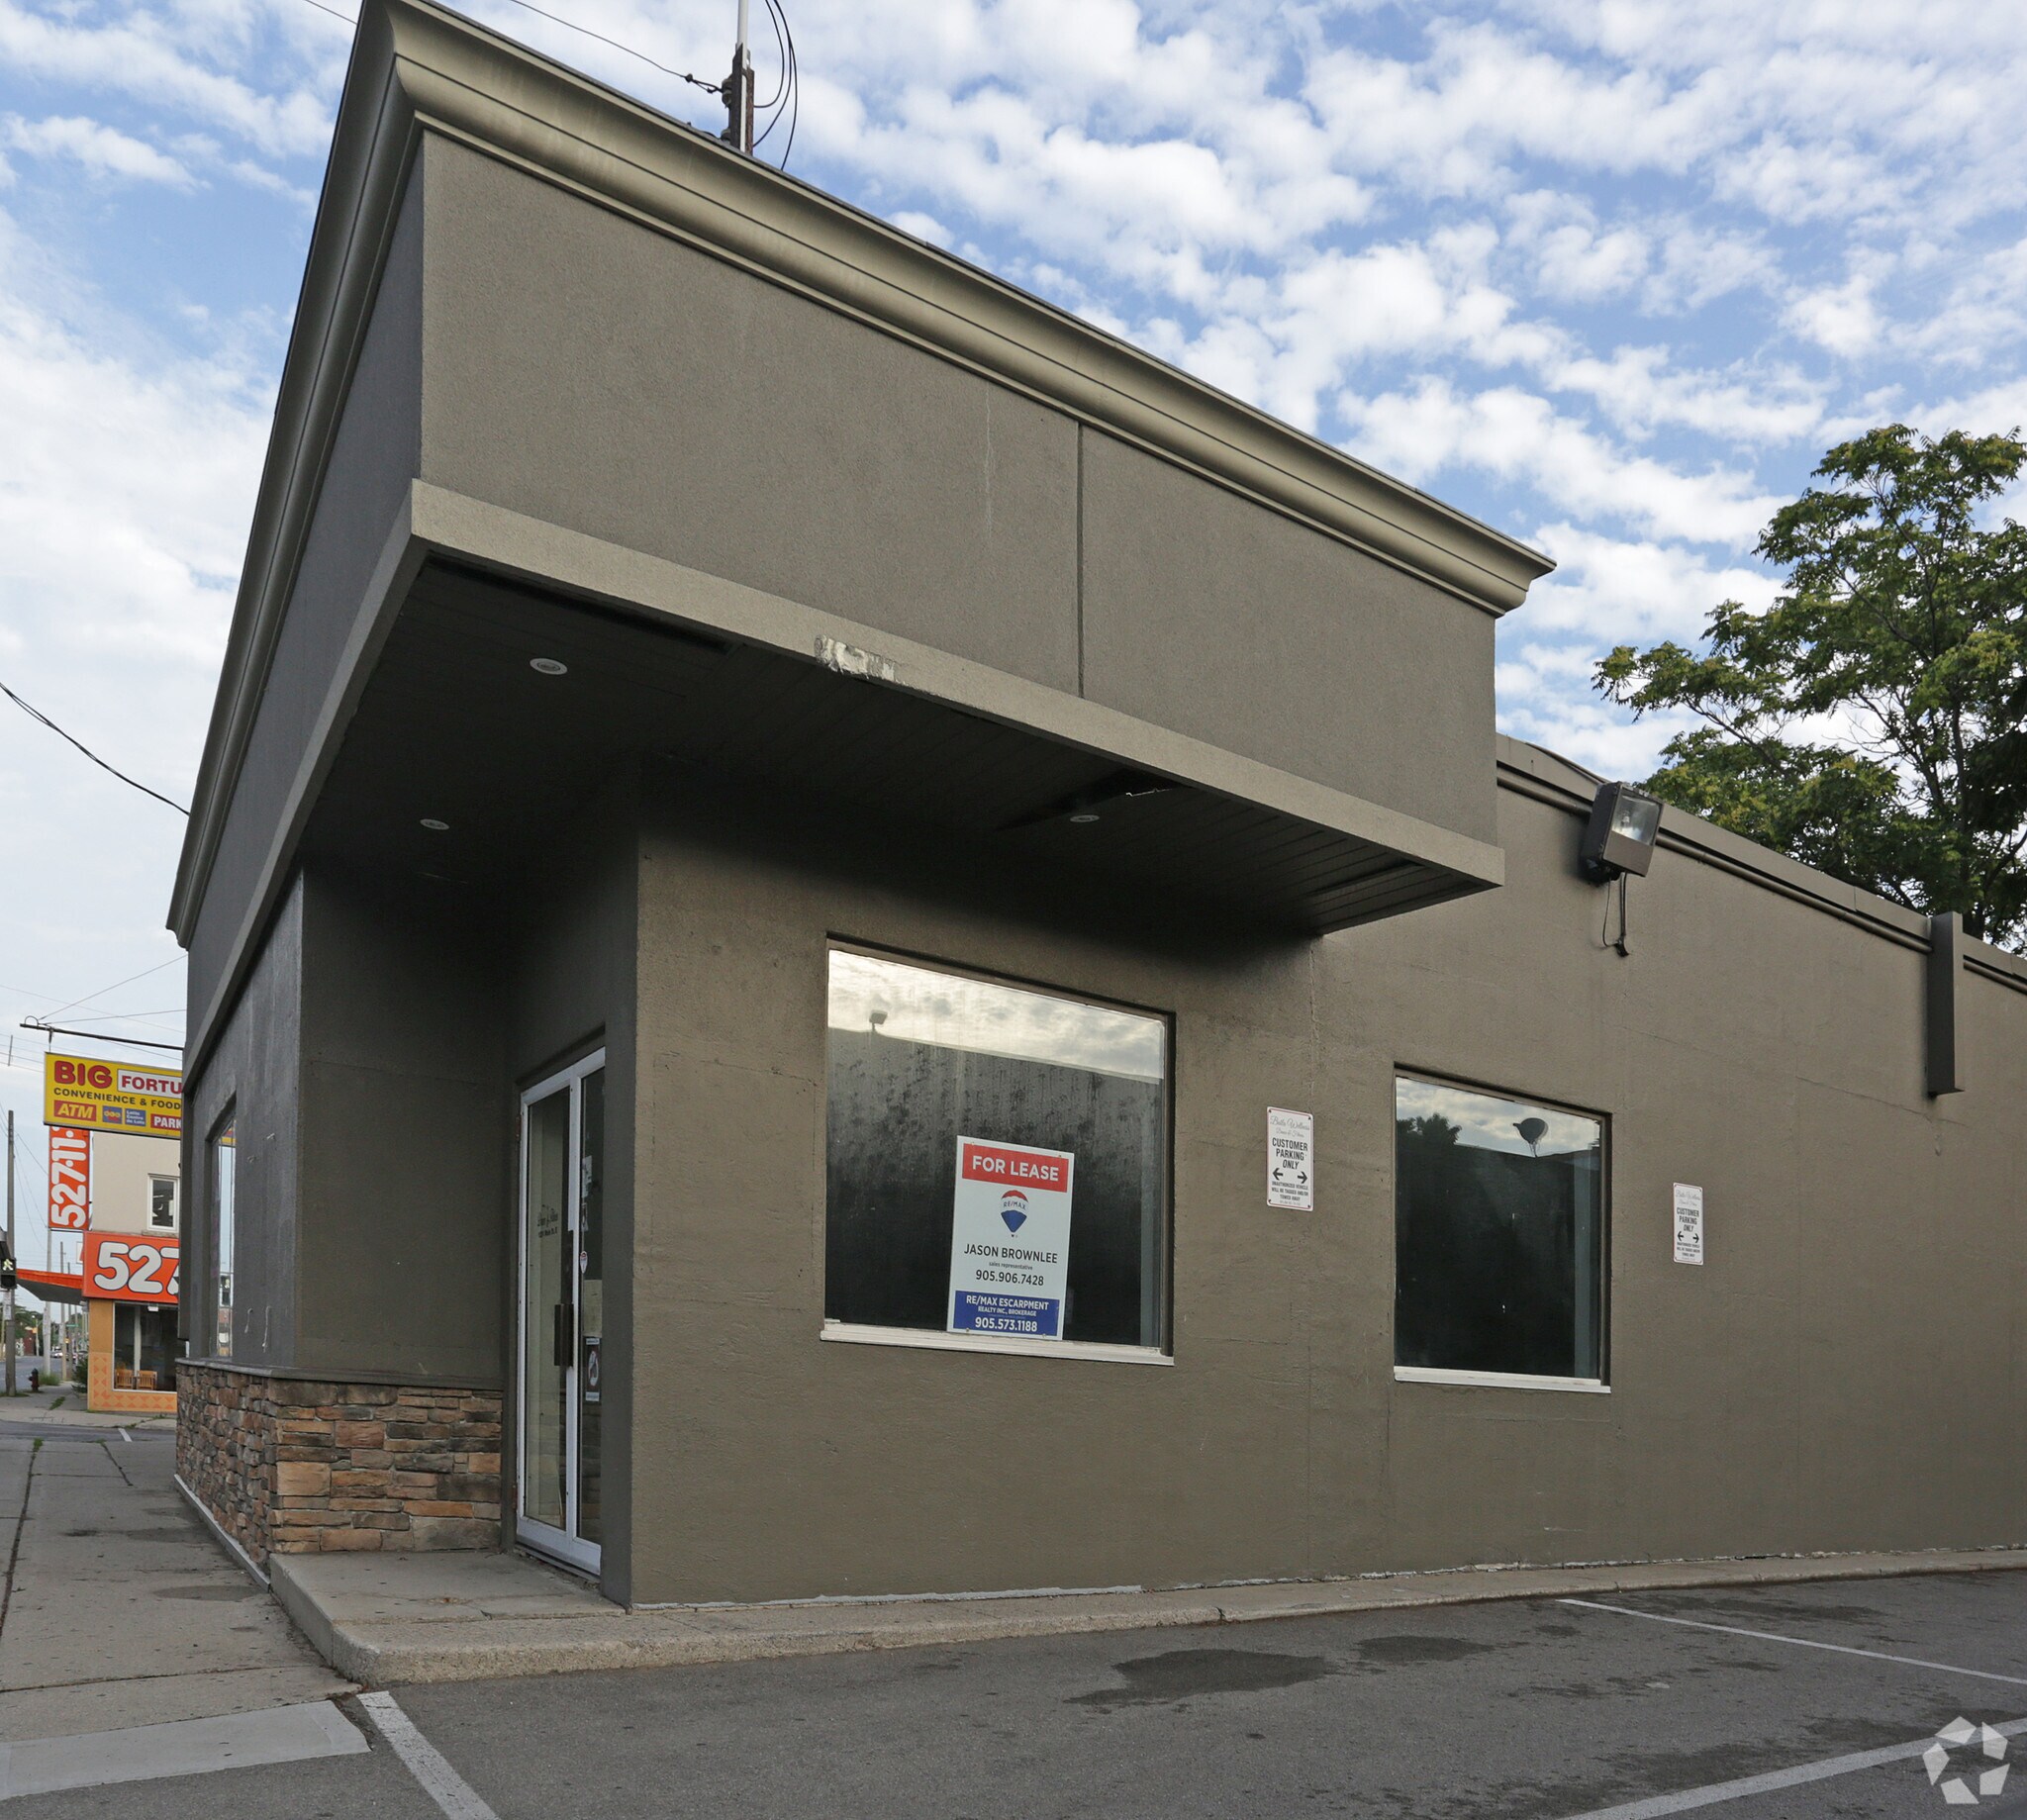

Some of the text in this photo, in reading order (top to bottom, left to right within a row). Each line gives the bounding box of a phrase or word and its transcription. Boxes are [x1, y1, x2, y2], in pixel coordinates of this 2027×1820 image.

[54, 1060, 113, 1089] BIG
[53, 1087, 136, 1105] CONVENIENCE
[140, 1098, 147, 1106] &
[57, 1103, 94, 1119] ATM
[1272, 1137, 1308, 1151] CUSTOMER
[1276, 1148, 1304, 1161] PARKING
[972, 1155, 1059, 1182] FOR LEASE
[1283, 1159, 1300, 1170] ONLY
[1003, 1200, 1026, 1210] RE/MAX
[1677, 1207, 1699, 1217] CUSTOMER
[1679, 1216, 1697, 1225] PARKING
[964, 1243, 1058, 1264] JASON BROWNLEE
[975, 1269, 1044, 1287] 905.906.7428
[966, 1294, 1049, 1310] RE/MAX ESCARPMENT
[1008, 1308, 1037, 1317] BROKERAGE
[975, 1316, 1038, 1332] 905.573.1188
